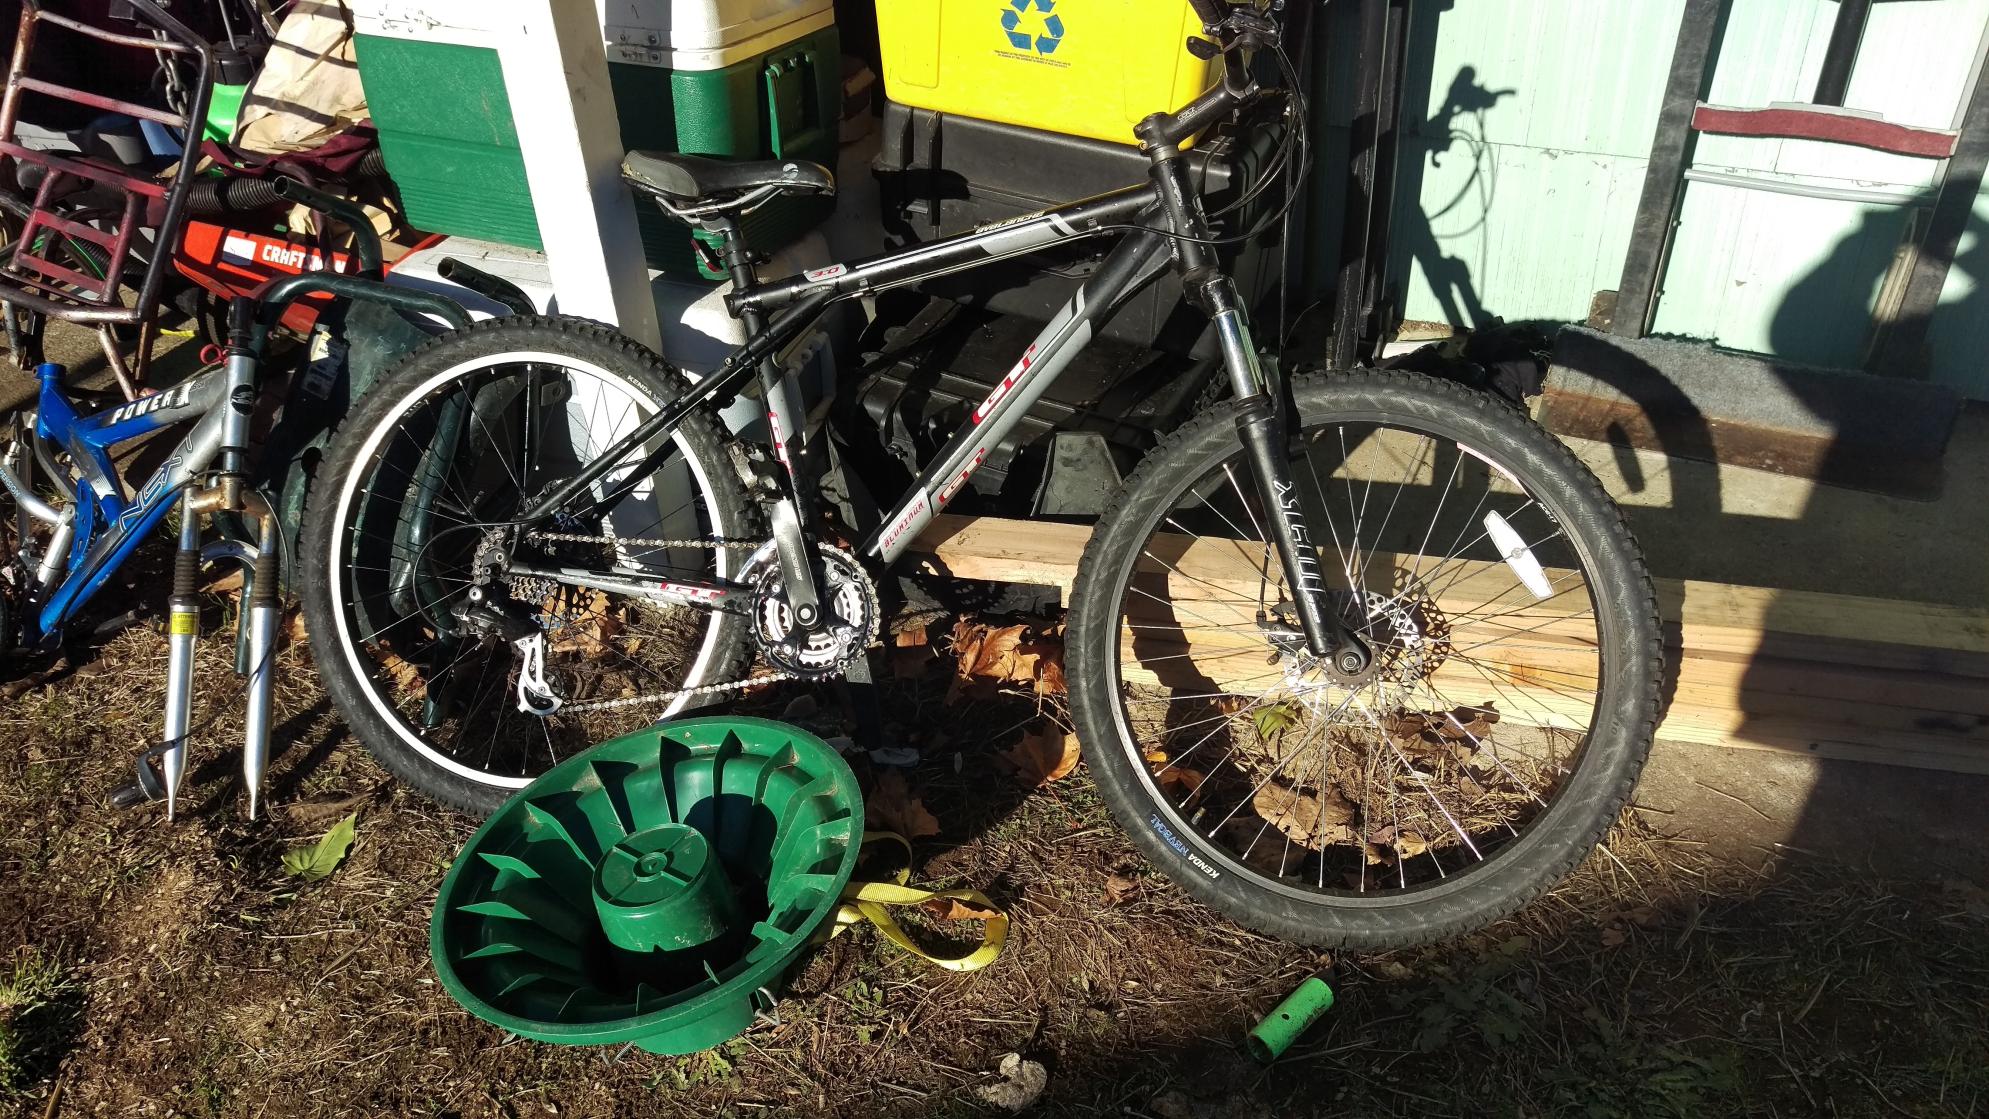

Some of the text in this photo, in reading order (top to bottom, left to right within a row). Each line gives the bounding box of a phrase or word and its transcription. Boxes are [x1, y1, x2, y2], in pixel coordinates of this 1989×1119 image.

[111, 390, 176, 424] POWER
[627, 374, 652, 396] KENDA
[972, 343, 1037, 425] GT
[119, 427, 197, 533] NEXT
[938, 447, 986, 505] GT
[1188, 853, 1220, 879] KENDA
